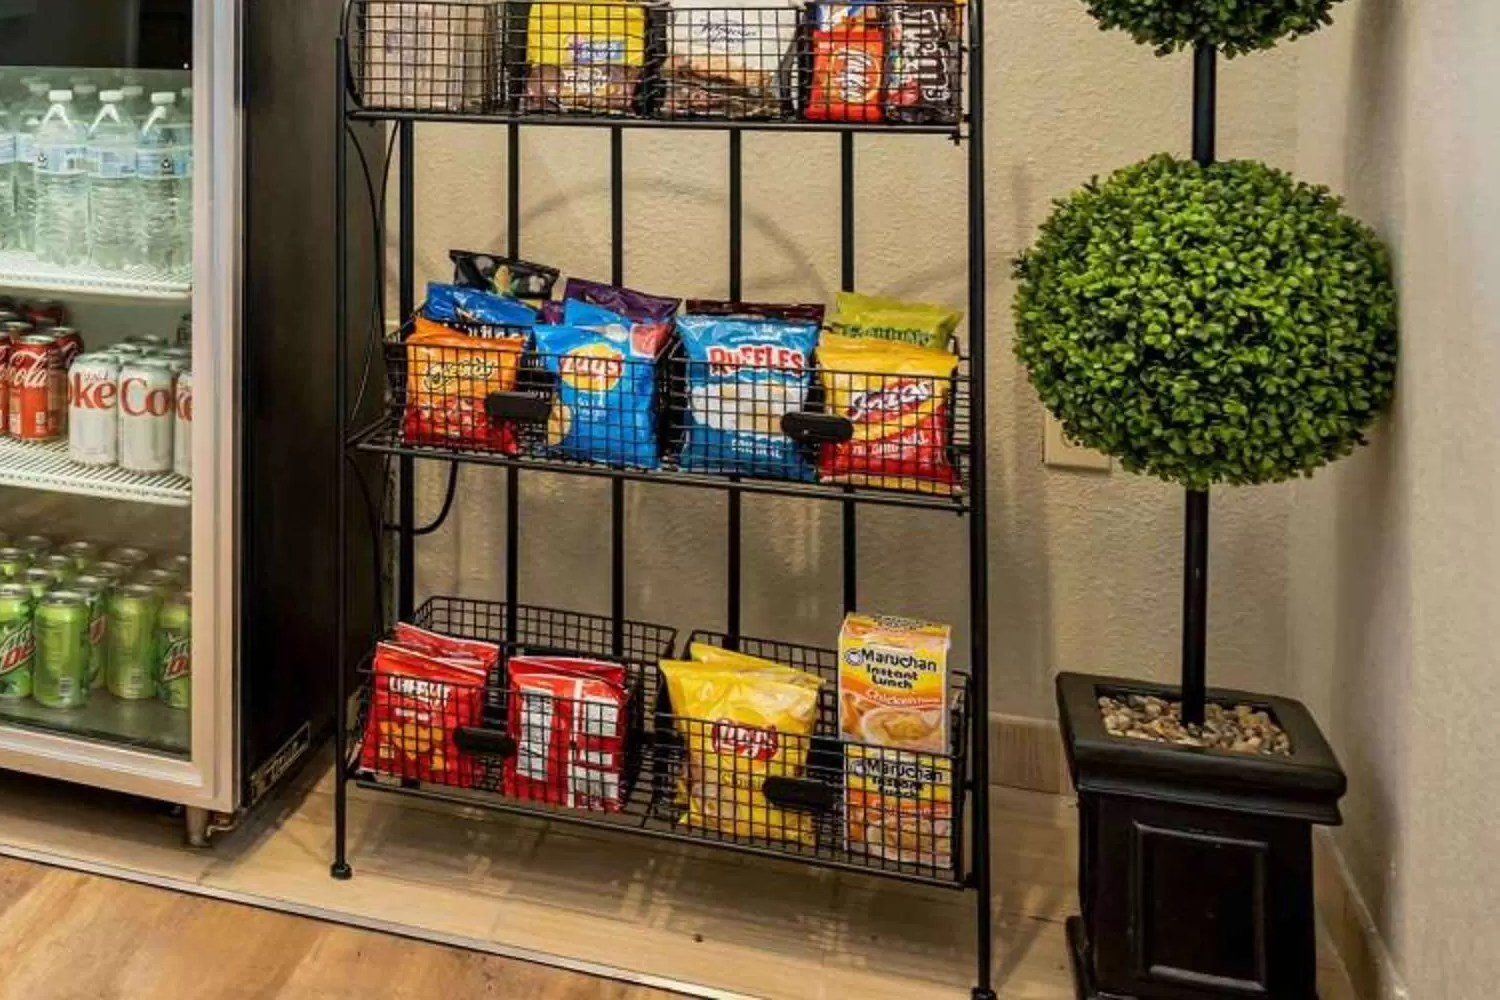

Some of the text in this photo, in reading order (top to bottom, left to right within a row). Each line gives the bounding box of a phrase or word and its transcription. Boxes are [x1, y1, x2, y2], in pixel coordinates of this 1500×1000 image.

[707, 344, 804, 377] RUFFLES
[861, 647, 938, 673] Maruchan
[866, 663, 919, 681] Instant
[871, 675, 914, 689] Lunch
